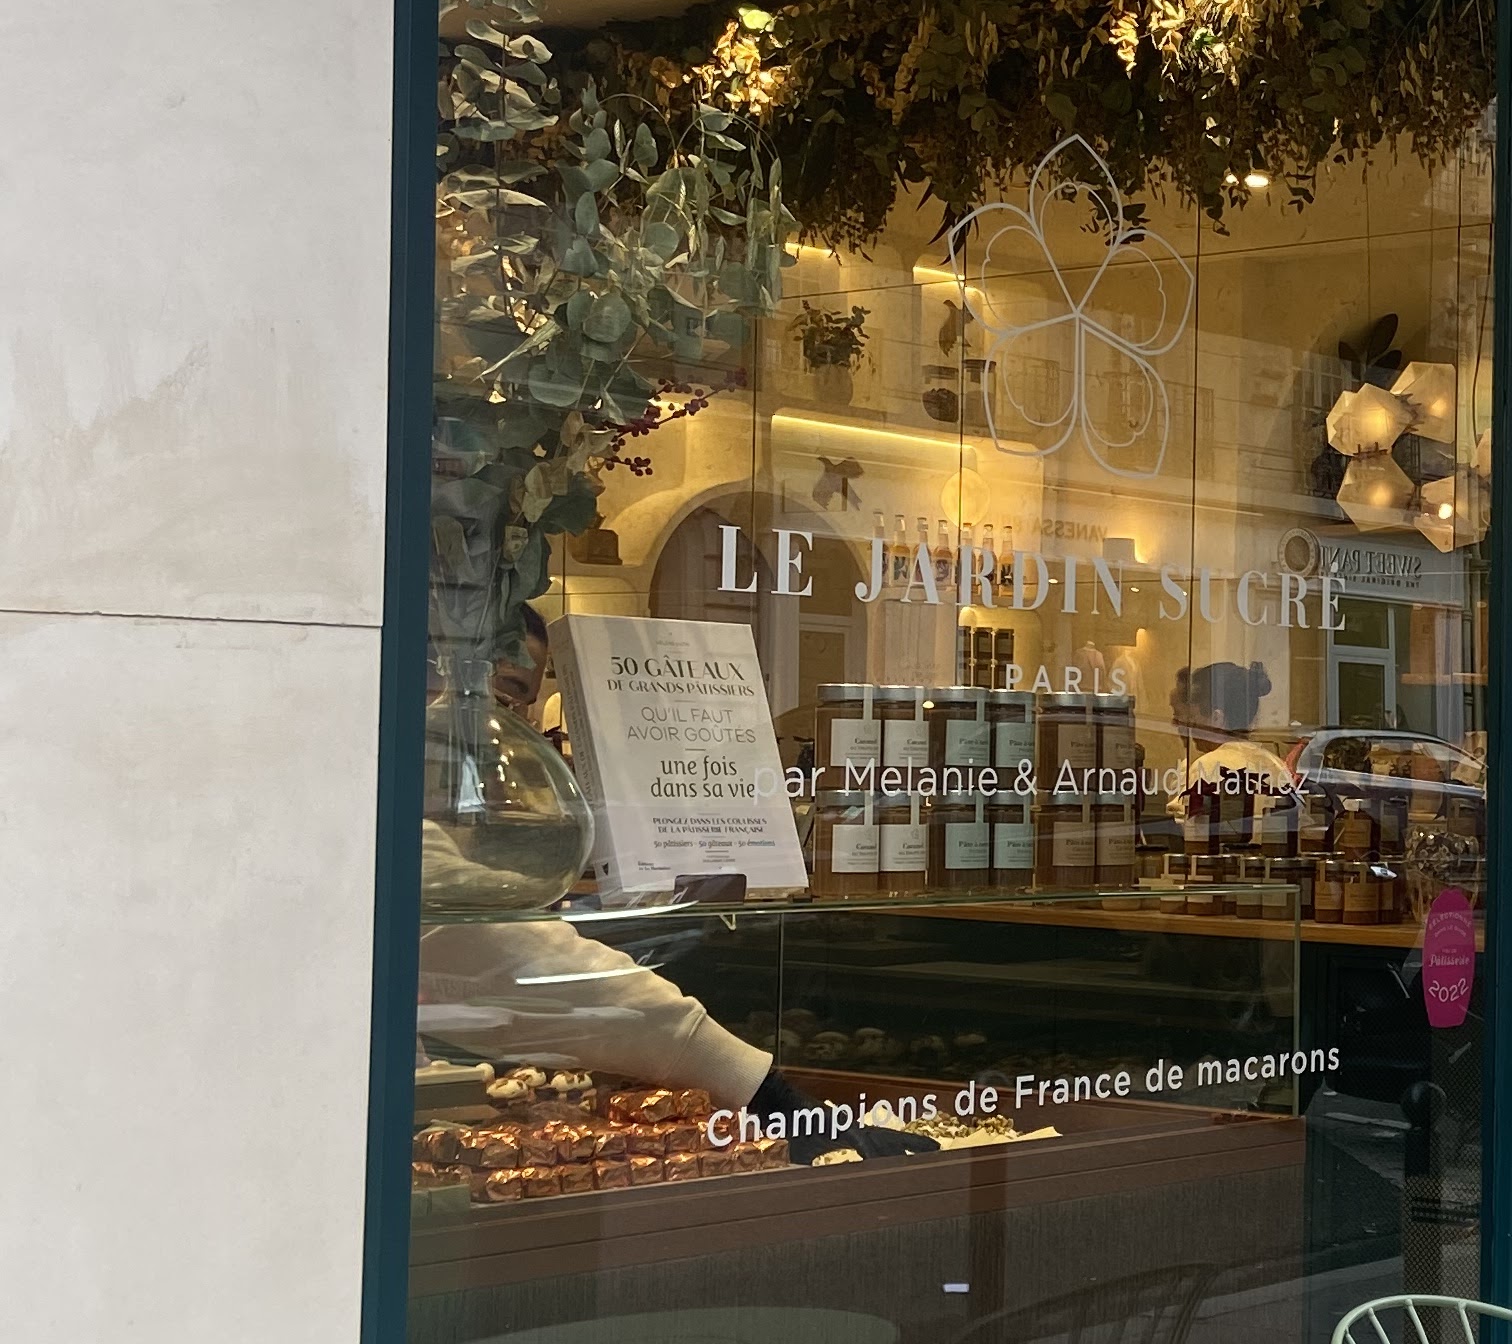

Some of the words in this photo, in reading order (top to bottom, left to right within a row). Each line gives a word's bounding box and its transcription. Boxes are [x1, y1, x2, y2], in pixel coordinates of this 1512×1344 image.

[716, 523, 815, 598] LE
[855, 544, 1125, 618] JARDIN
[1157, 560, 1347, 632] SUCRÉ
[611, 656, 639, 676] 50
[644, 654, 745, 681] GÂTEAUX
[1005, 662, 1128, 698] PARIS
[607, 679, 624, 692] DE
[629, 680, 685, 694] GRANDS
[687, 681, 755, 697] PÂTISSIERS
[641, 706, 687, 723] QU'IL
[691, 708, 733, 724] FAUT
[627, 725, 681, 742] AVOIR
[684, 724, 757, 744] GOÛTÉS
[661, 759, 698, 776] une
[702, 755, 738, 781] fois
[650, 777, 698, 798] dans
[703, 782, 724, 798] sa
[728, 777, 755, 798] vie
[754, 765, 826, 807] par
[844, 757, 999, 797] Melanie
[1013, 758, 1038, 796] &
[1052, 757, 1184, 796] Arnaud
[1428, 977, 1470, 1003] 2022
[706, 1092, 938, 1148] Champions
[954, 1080, 998, 1117] de
[1015, 1071, 1132, 1110] France
[1145, 1058, 1184, 1091] de
[1198, 1045, 1340, 1086] macarons
